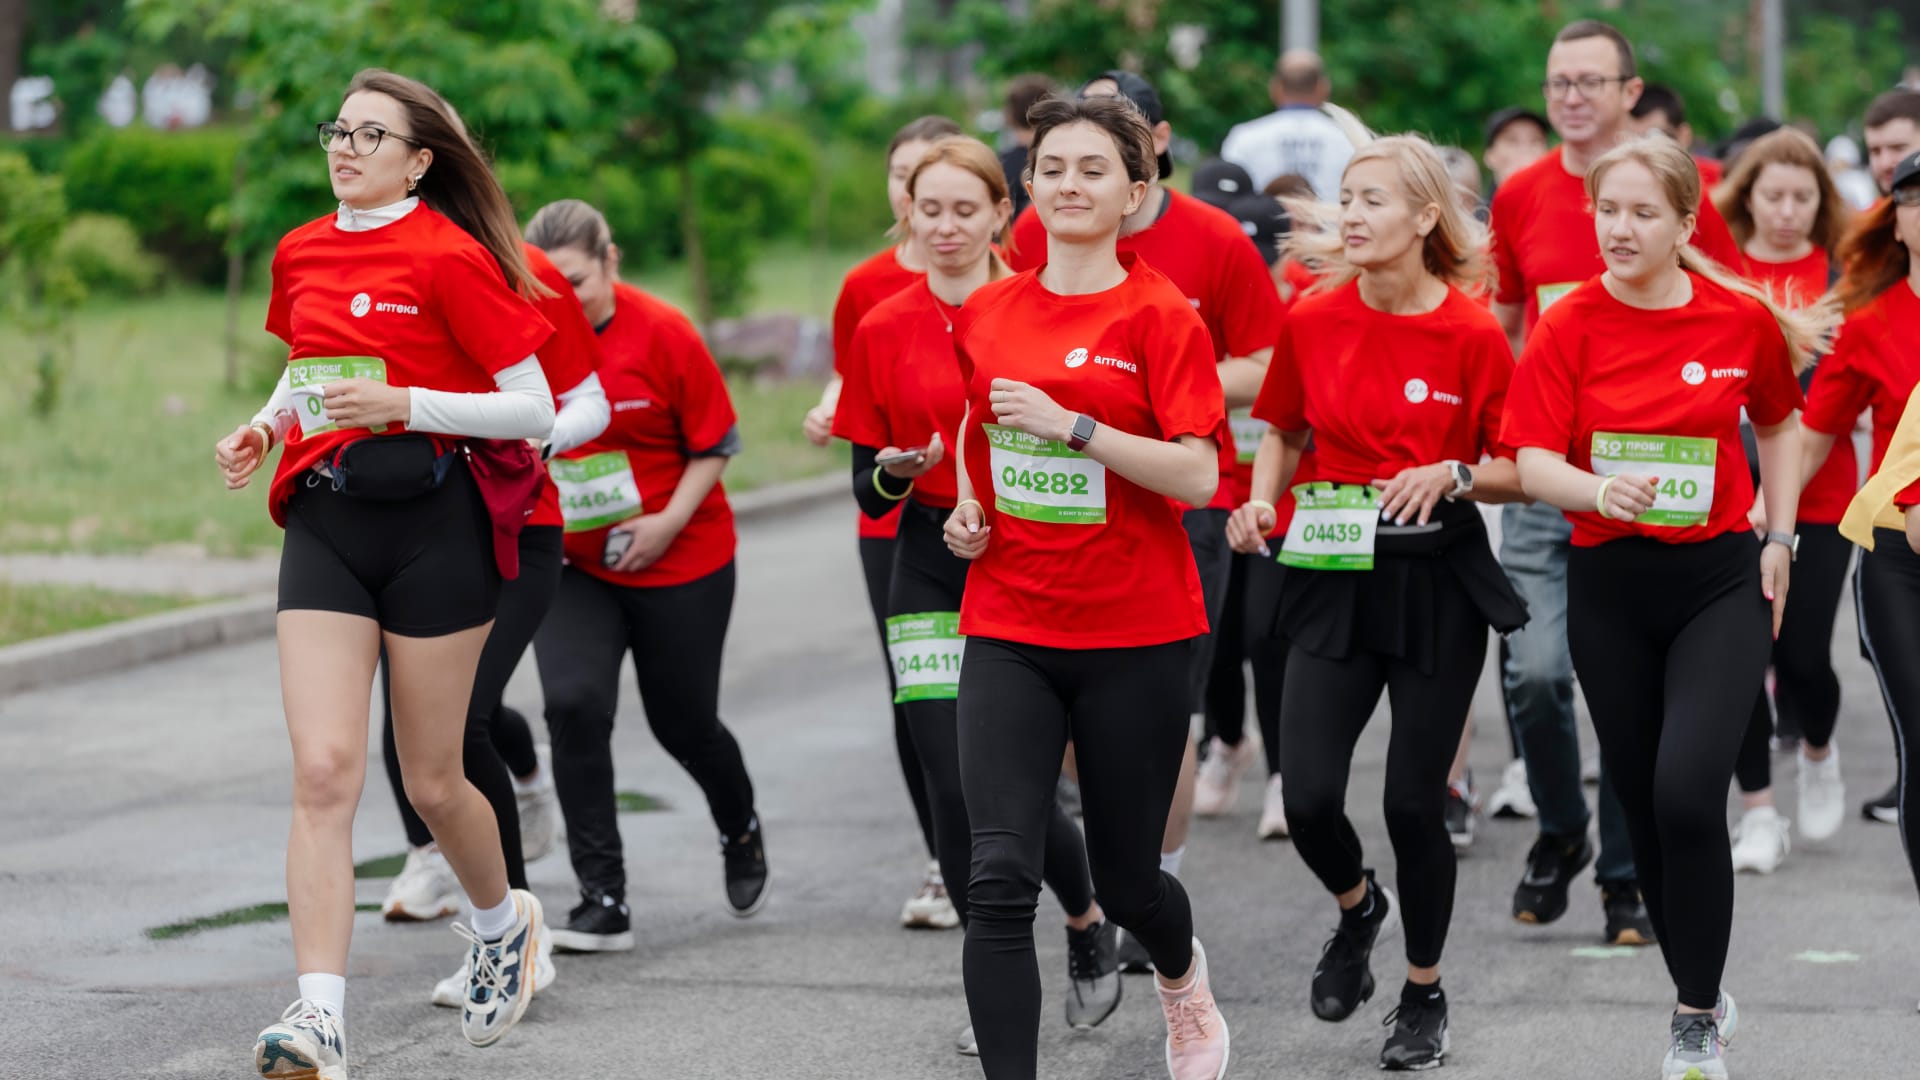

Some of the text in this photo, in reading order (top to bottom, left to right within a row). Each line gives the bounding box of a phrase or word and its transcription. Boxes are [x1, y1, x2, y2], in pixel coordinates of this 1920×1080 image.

[375, 302, 418, 315] аптека
[1094, 355, 1137, 373] аптека
[1002, 466, 1089, 495] 04282
[1303, 524, 1362, 543] 04439
[898, 653, 960, 675] 04411
